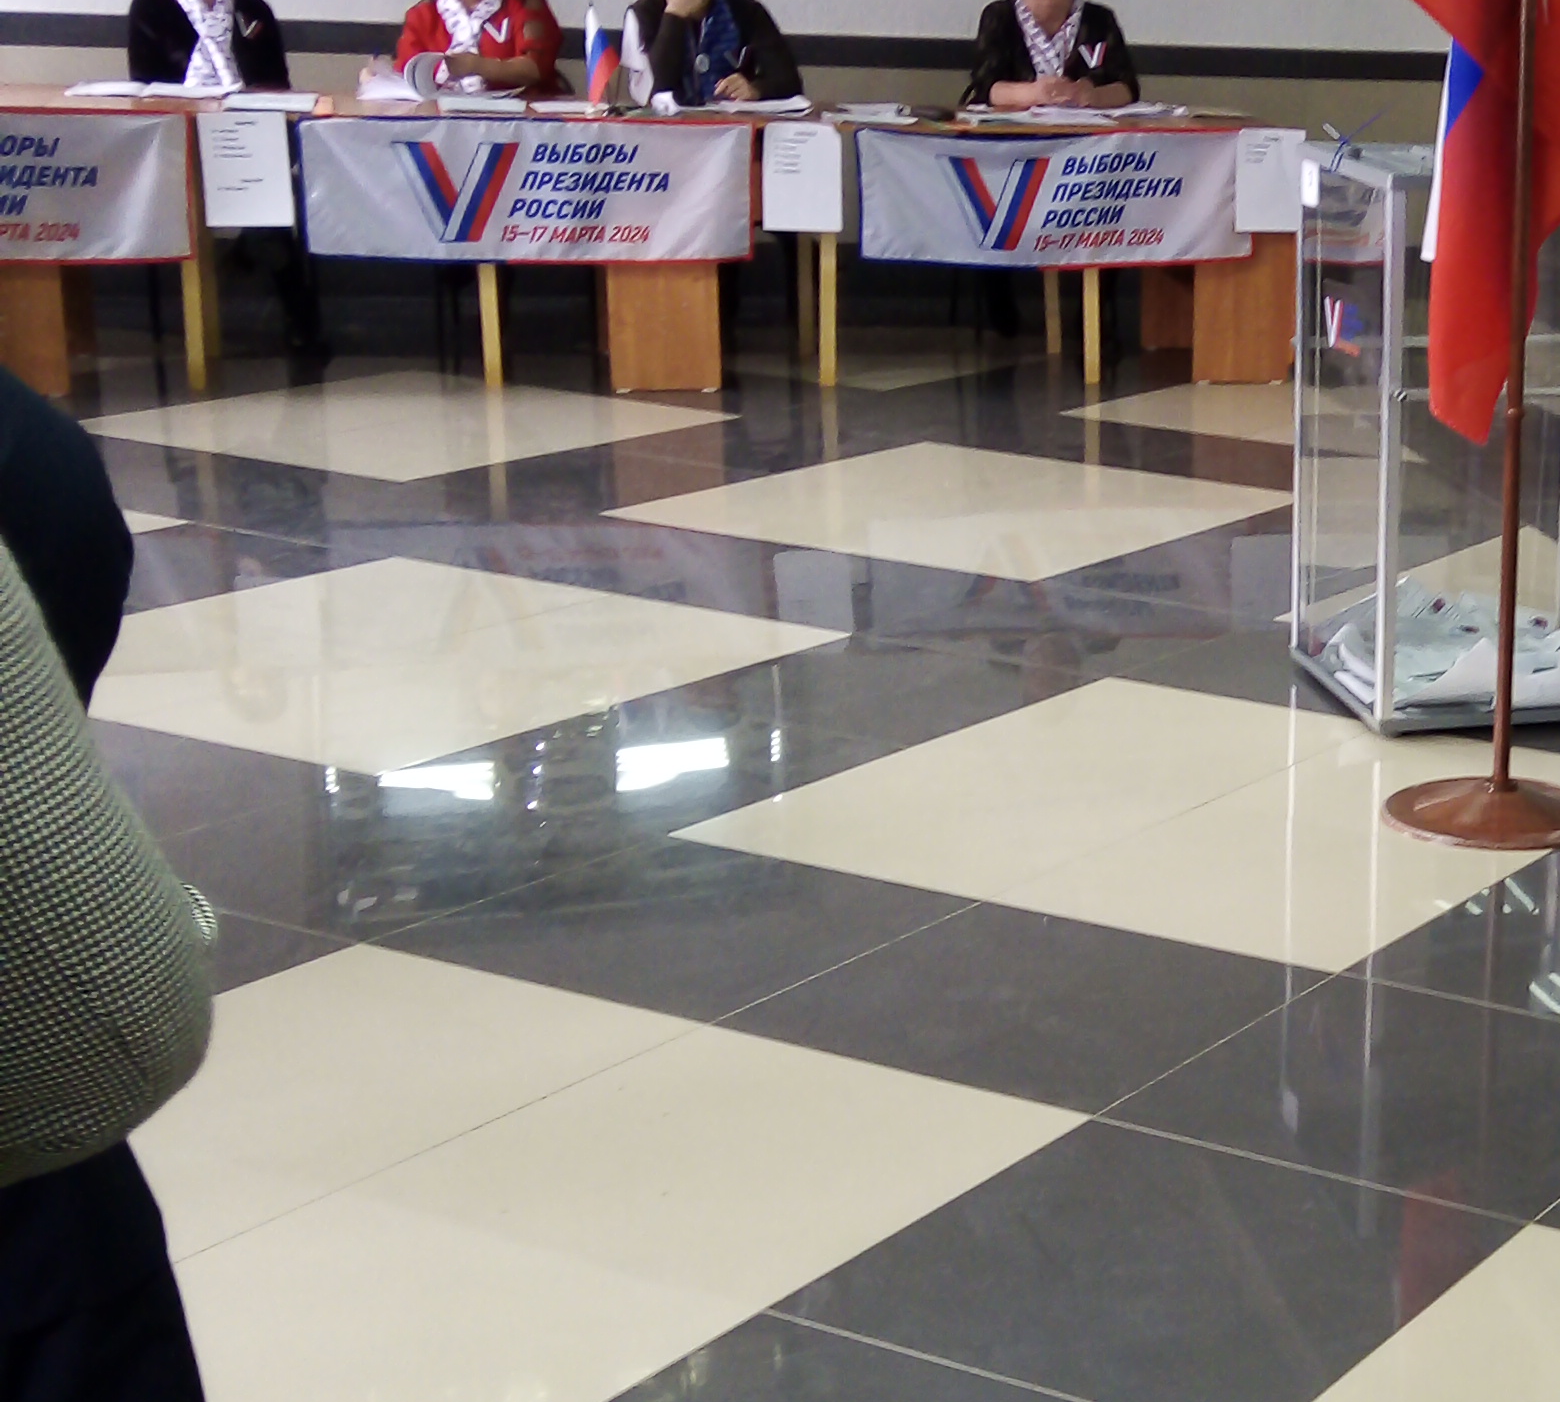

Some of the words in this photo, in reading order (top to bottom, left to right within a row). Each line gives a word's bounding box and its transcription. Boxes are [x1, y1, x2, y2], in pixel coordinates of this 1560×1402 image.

[531, 142, 639, 165] ВЫБОРЫ
[1061, 151, 1159, 176] ВЫБОРЫ
[519, 170, 671, 194] ПРЕЗИДЕНТА
[1051, 177, 1183, 202] ПРЕЗИДЕНТА
[507, 197, 607, 219] РОССИИ
[1041, 204, 1126, 229] РОССИИ
[33, 222, 80, 242] 2024
[548, 225, 606, 243] МАРТА
[608, 225, 650, 243] 2024
[1075, 229, 1125, 249] МАРТА
[1126, 228, 1165, 246] 2024
